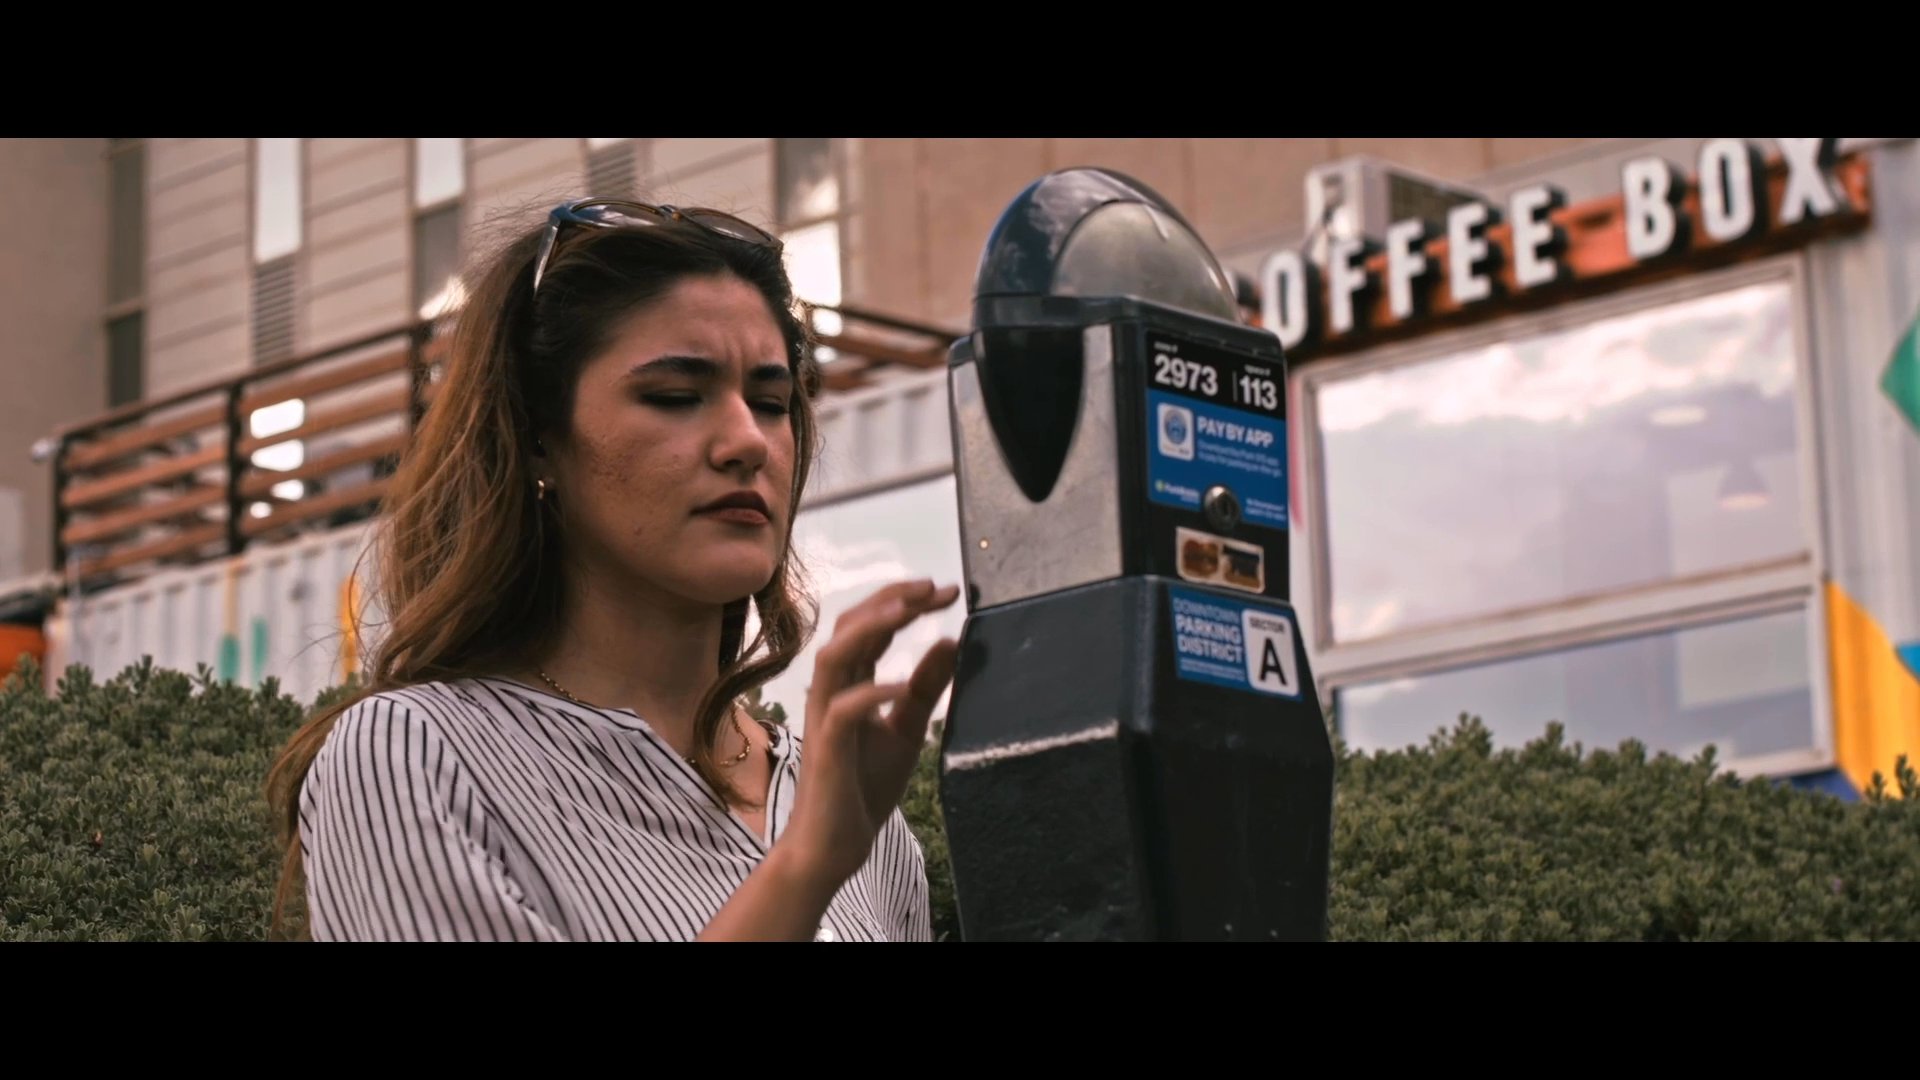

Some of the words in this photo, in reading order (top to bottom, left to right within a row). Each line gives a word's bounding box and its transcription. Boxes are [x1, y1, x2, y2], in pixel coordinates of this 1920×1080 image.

[1228, 185, 1557, 350] OFFEE
[1622, 138, 1837, 260] BOX
[1154, 353, 1219, 396] 2973
[1239, 375, 1278, 411] 113
[1197, 416, 1225, 438] PAY
[1225, 423, 1245, 442] BY
[1245, 427, 1274, 448] APP
[1173, 598, 1240, 623] DOWNTOWN
[1249, 617, 1285, 634] SECTOR
[1175, 615, 1241, 644] PARKING
[1178, 634, 1243, 664] DISTRICT
[1259, 637, 1288, 686] A
